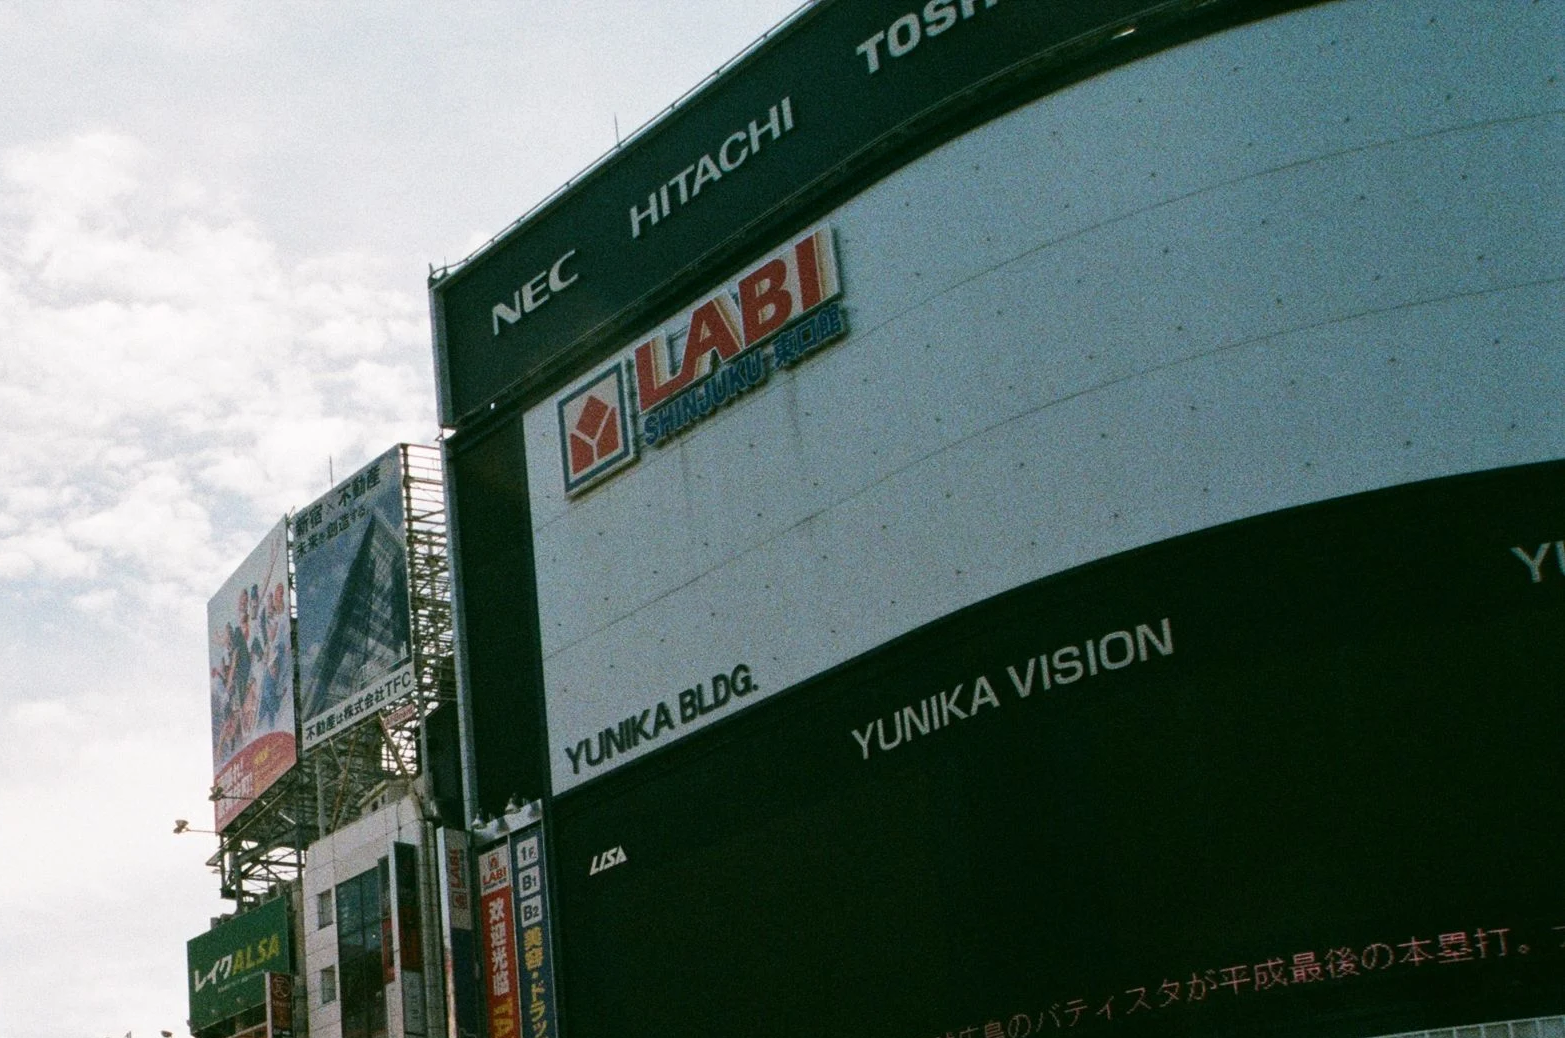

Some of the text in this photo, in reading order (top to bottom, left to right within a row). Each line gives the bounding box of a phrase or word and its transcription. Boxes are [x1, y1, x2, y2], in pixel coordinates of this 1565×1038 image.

[628, 96, 795, 239] HITACHI
[490, 249, 580, 336] NEC
[634, 228, 840, 416] LABI
[642, 350, 767, 447] SHINJUKU
[564, 663, 759, 774] YUNIKA BLDG.
[850, 617, 1176, 761] YUNIKA VISION
[589, 843, 628, 877] LISA
